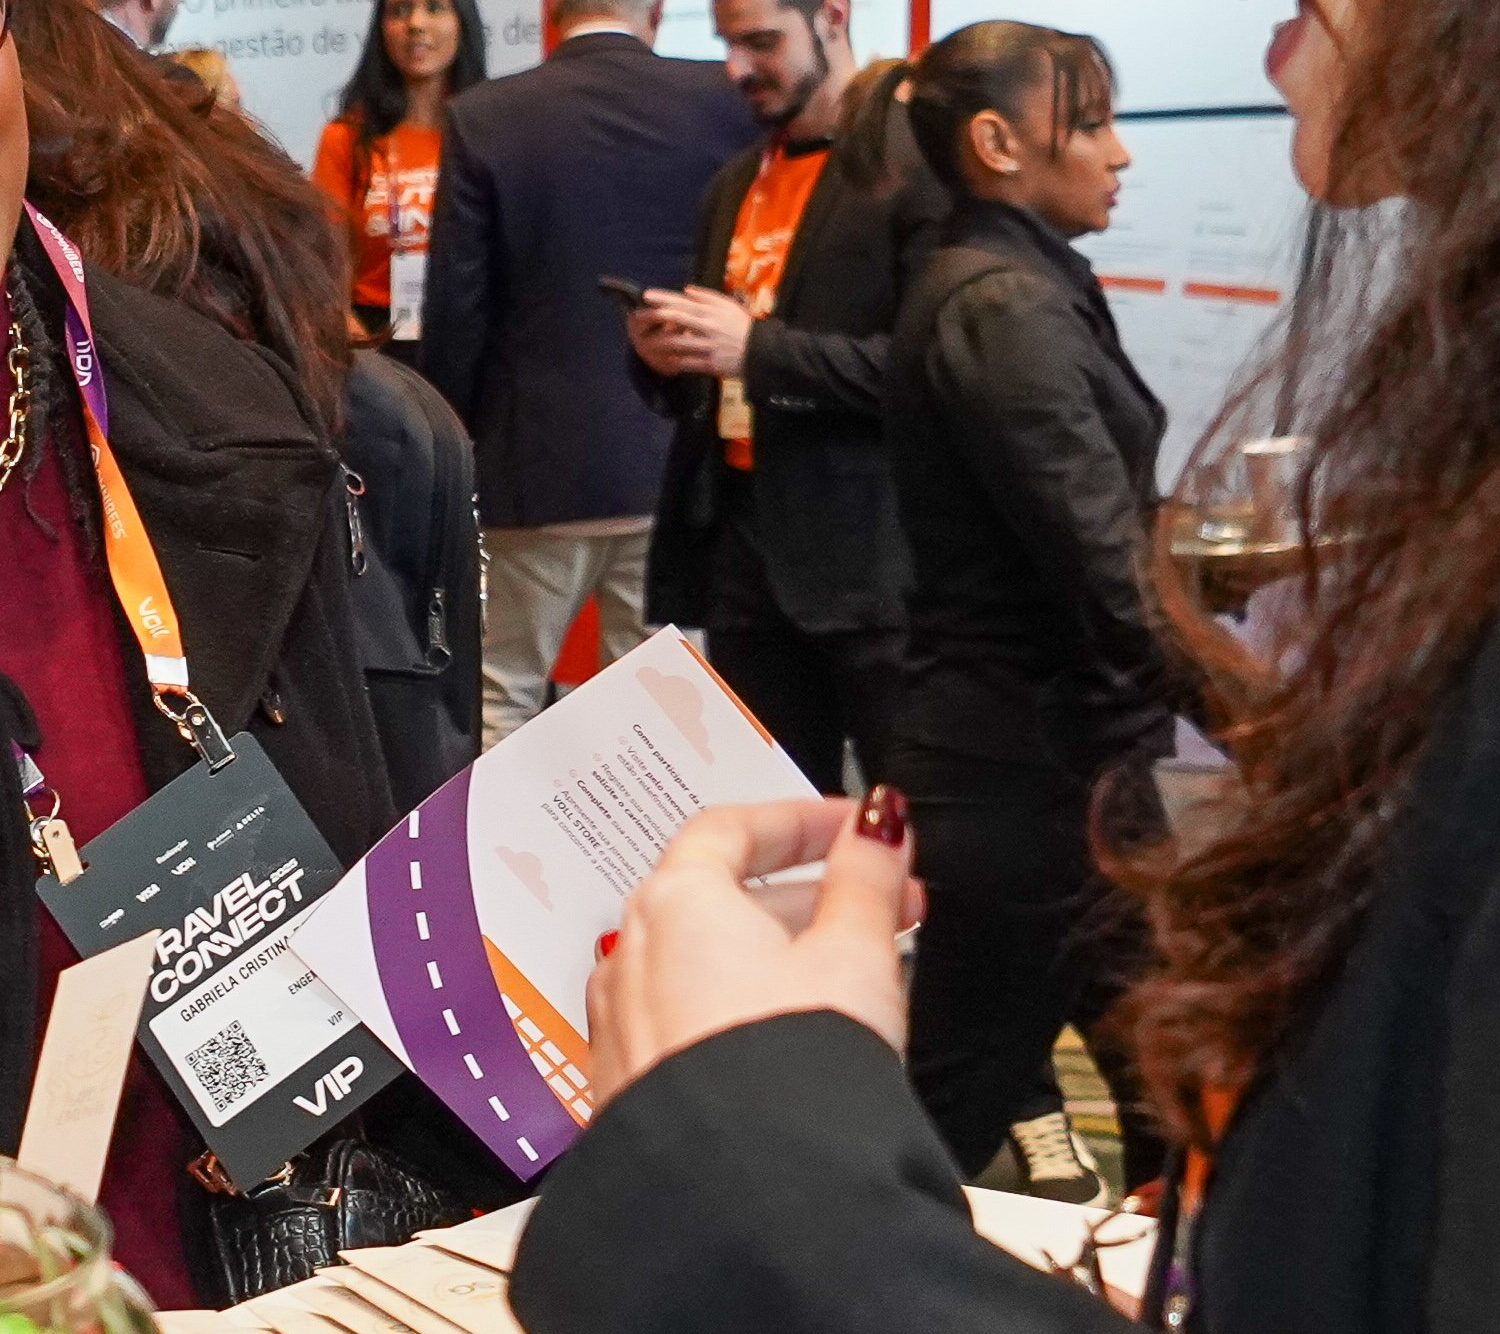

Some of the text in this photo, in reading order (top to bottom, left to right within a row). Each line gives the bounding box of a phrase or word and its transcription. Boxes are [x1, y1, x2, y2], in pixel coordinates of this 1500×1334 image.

[76, 340, 93, 387] VOLL
[137, 595, 171, 640] VOLL
[632, 723, 699, 804] Como participar da
[643, 771, 663, 791] pelo
[553, 794, 573, 820] VOLL
[572, 819, 600, 849] STORE
[576, 779, 611, 819] Complete
[591, 770, 618, 799] solicite
[624, 808, 654, 841] carimbo
[148, 872, 272, 975] RAVEL
[150, 868, 305, 1004] CONNECT
[180, 975, 240, 1023] GABRIELA
[327, 1009, 345, 1028] VIP
[292, 1056, 365, 1117] VIP
